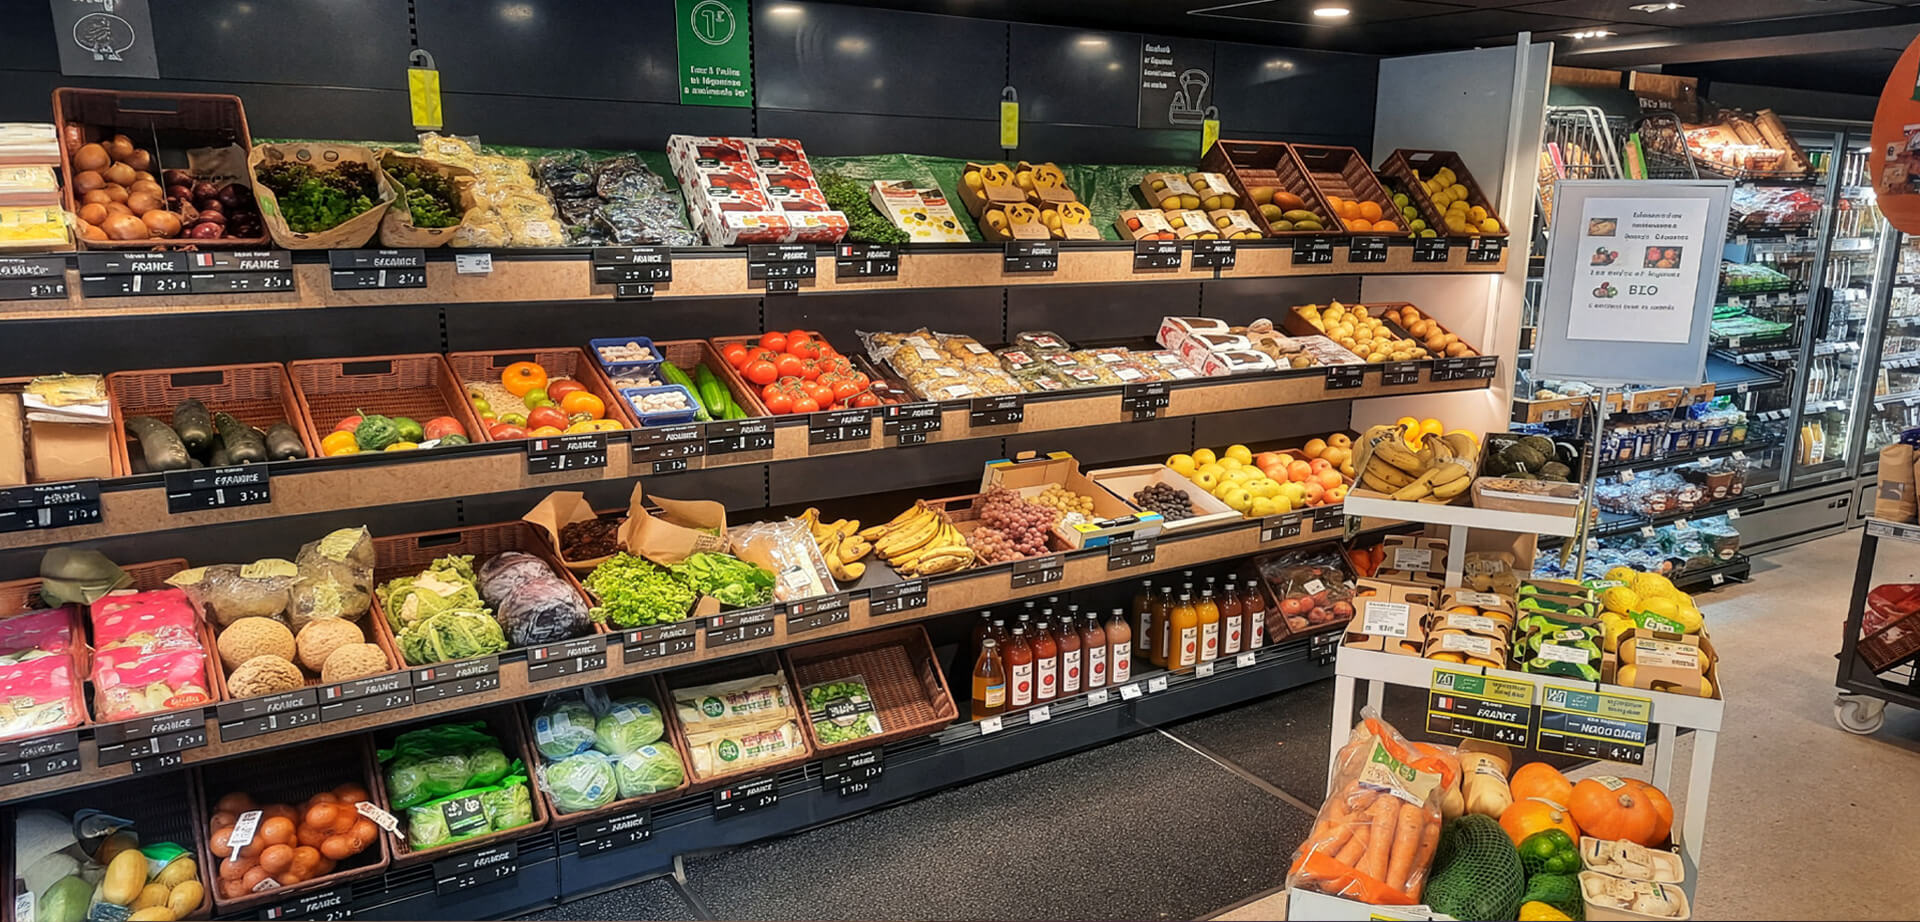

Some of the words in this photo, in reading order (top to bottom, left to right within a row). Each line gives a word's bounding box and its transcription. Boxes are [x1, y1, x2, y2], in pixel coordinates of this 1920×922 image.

[132, 262, 174, 272] FRANCE
[240, 259, 280, 270] FRANCE
[365, 681, 399, 694] FRANCE
[1476, 708, 1517, 722] FRANCE
[151, 718, 192, 733] FRANCE
